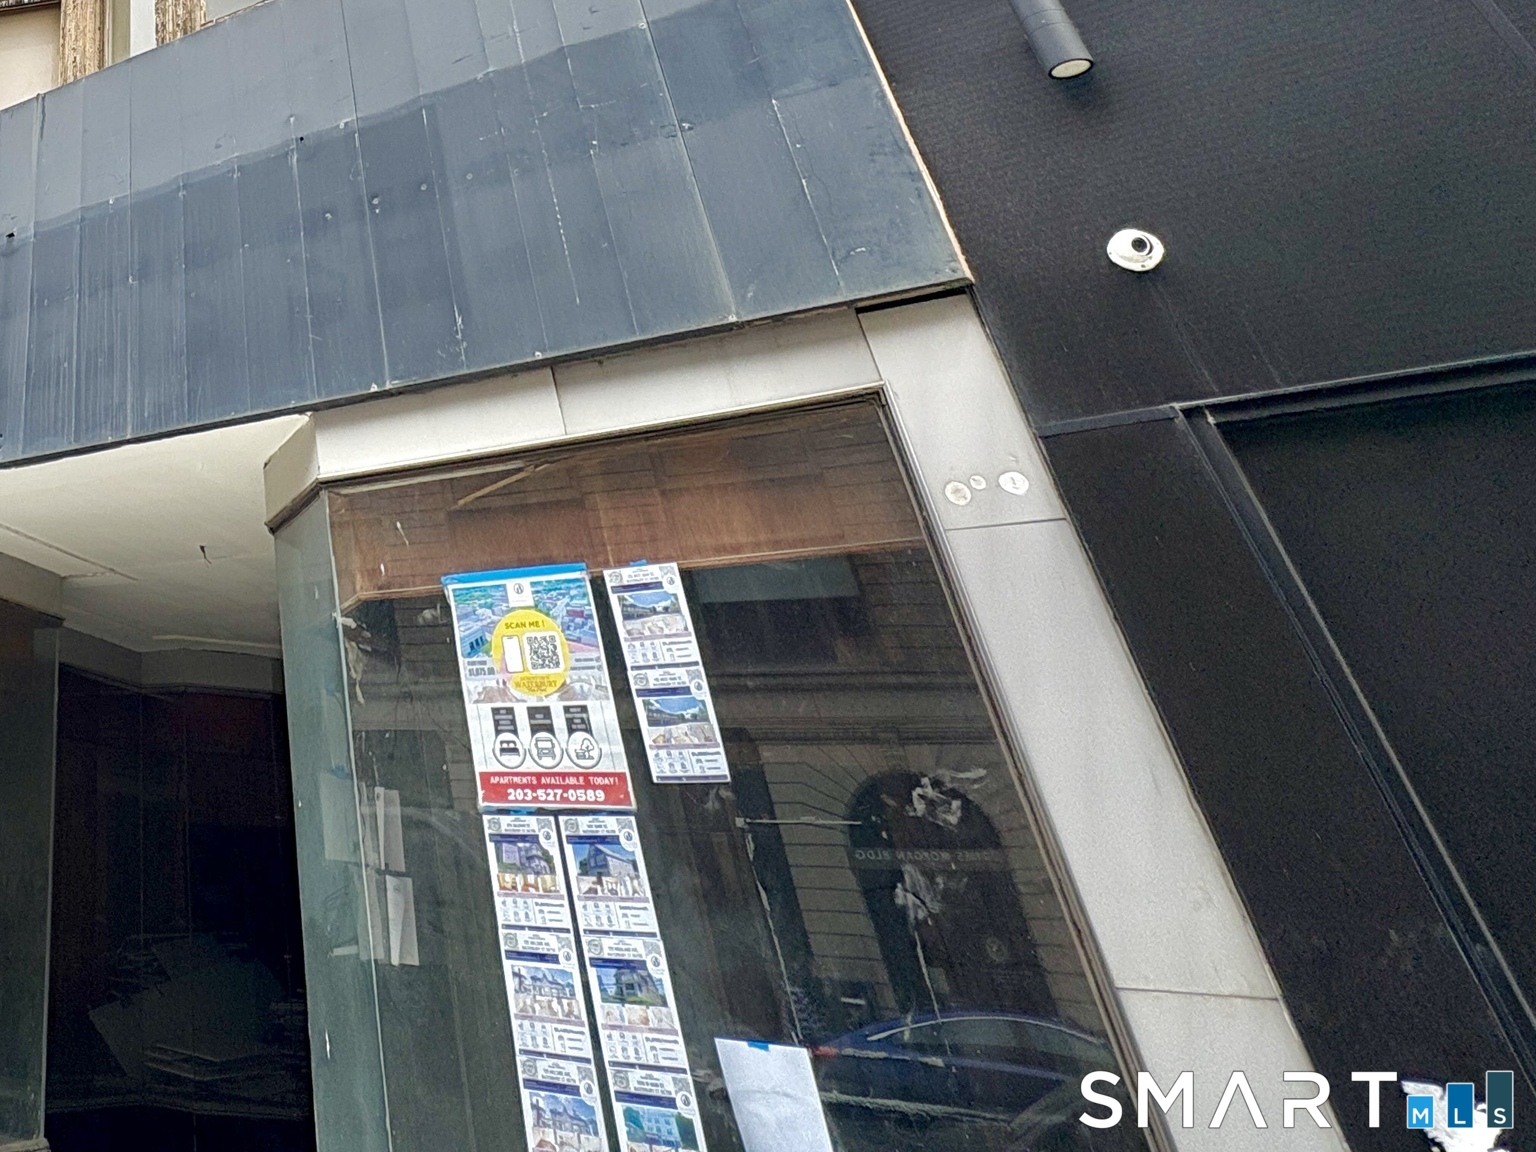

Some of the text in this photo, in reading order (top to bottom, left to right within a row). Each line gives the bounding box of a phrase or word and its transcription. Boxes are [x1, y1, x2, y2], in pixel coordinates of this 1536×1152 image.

[504, 621, 528, 630] SCAN
[529, 620, 540, 629] ME
[514, 680, 558, 688] WATERBURY
[490, 775, 619, 786] APARTMENTS AVAILABLE TODAY!
[507, 788, 606, 802] 203-527-0589
